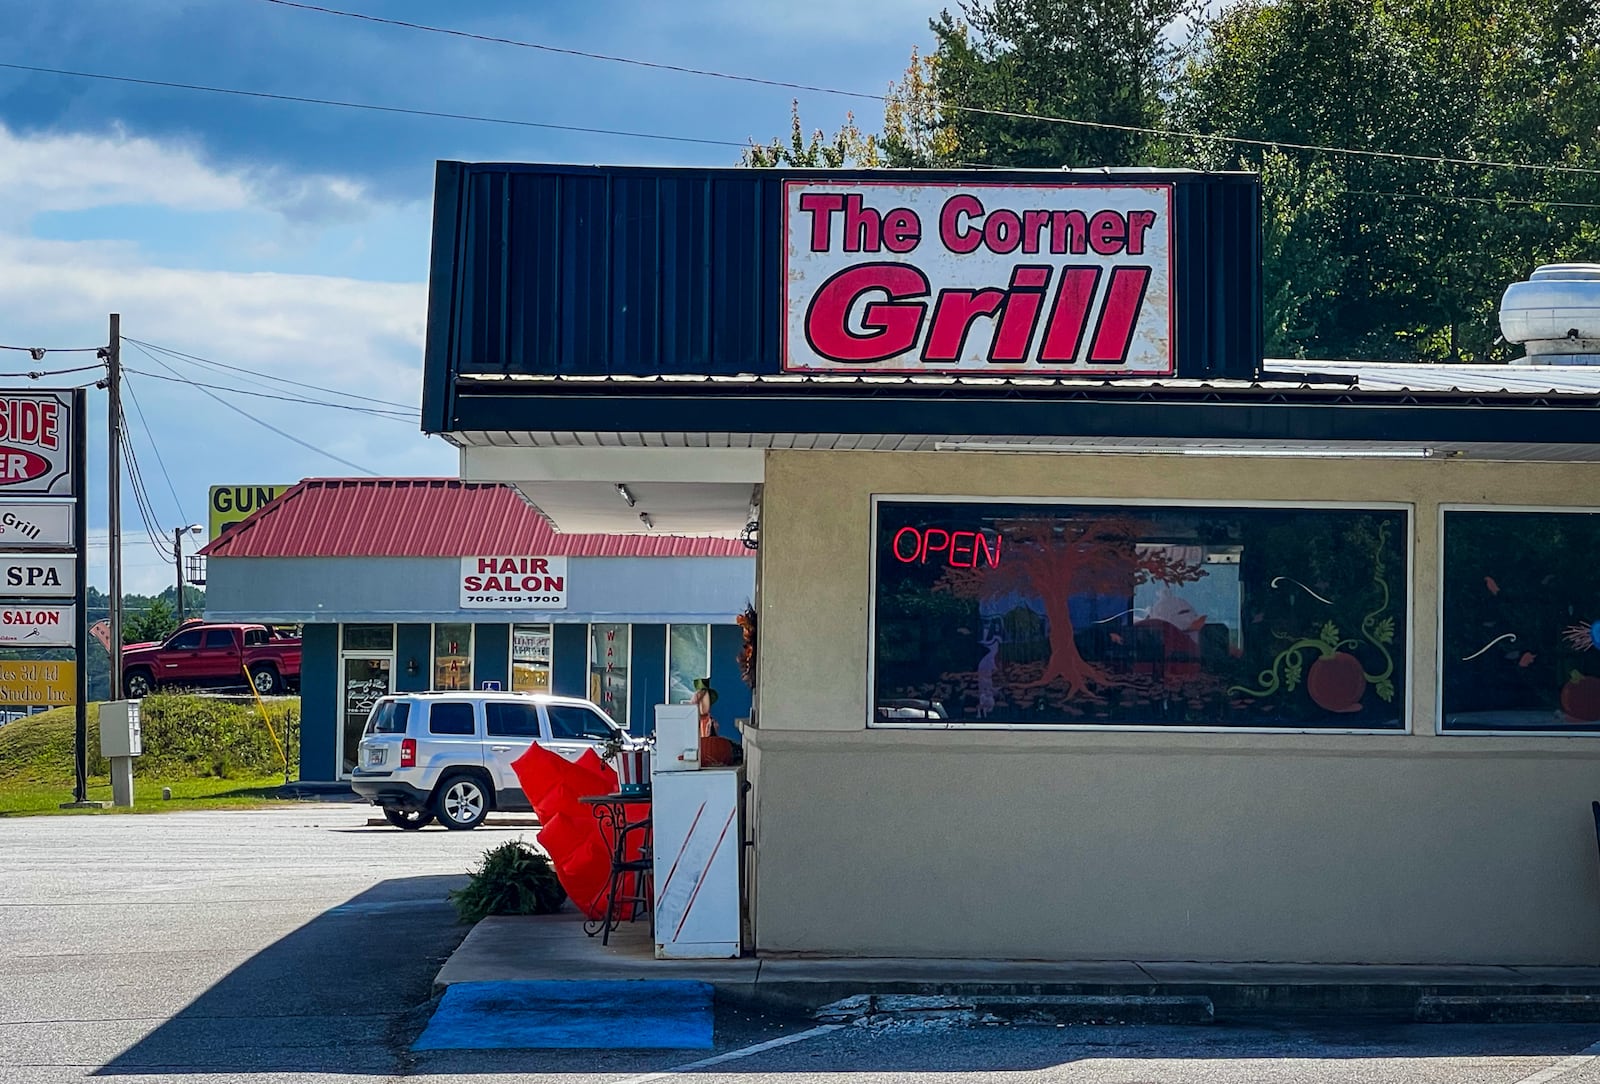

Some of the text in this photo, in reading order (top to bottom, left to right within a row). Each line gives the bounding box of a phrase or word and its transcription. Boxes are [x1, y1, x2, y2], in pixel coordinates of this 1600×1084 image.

[799, 192, 1157, 255] The Corner
[804, 261, 1152, 365] Grill
[213, 487, 274, 512] GUN
[2, 512, 41, 540] Grill
[893, 526, 1002, 569] OPEN
[7, 566, 62, 586] SPA
[478, 558, 549, 574] HAIR
[464, 576, 564, 592] SALON
[3, 611, 60, 625] SALON
[0, 685, 73, 702] Studio Inc.
